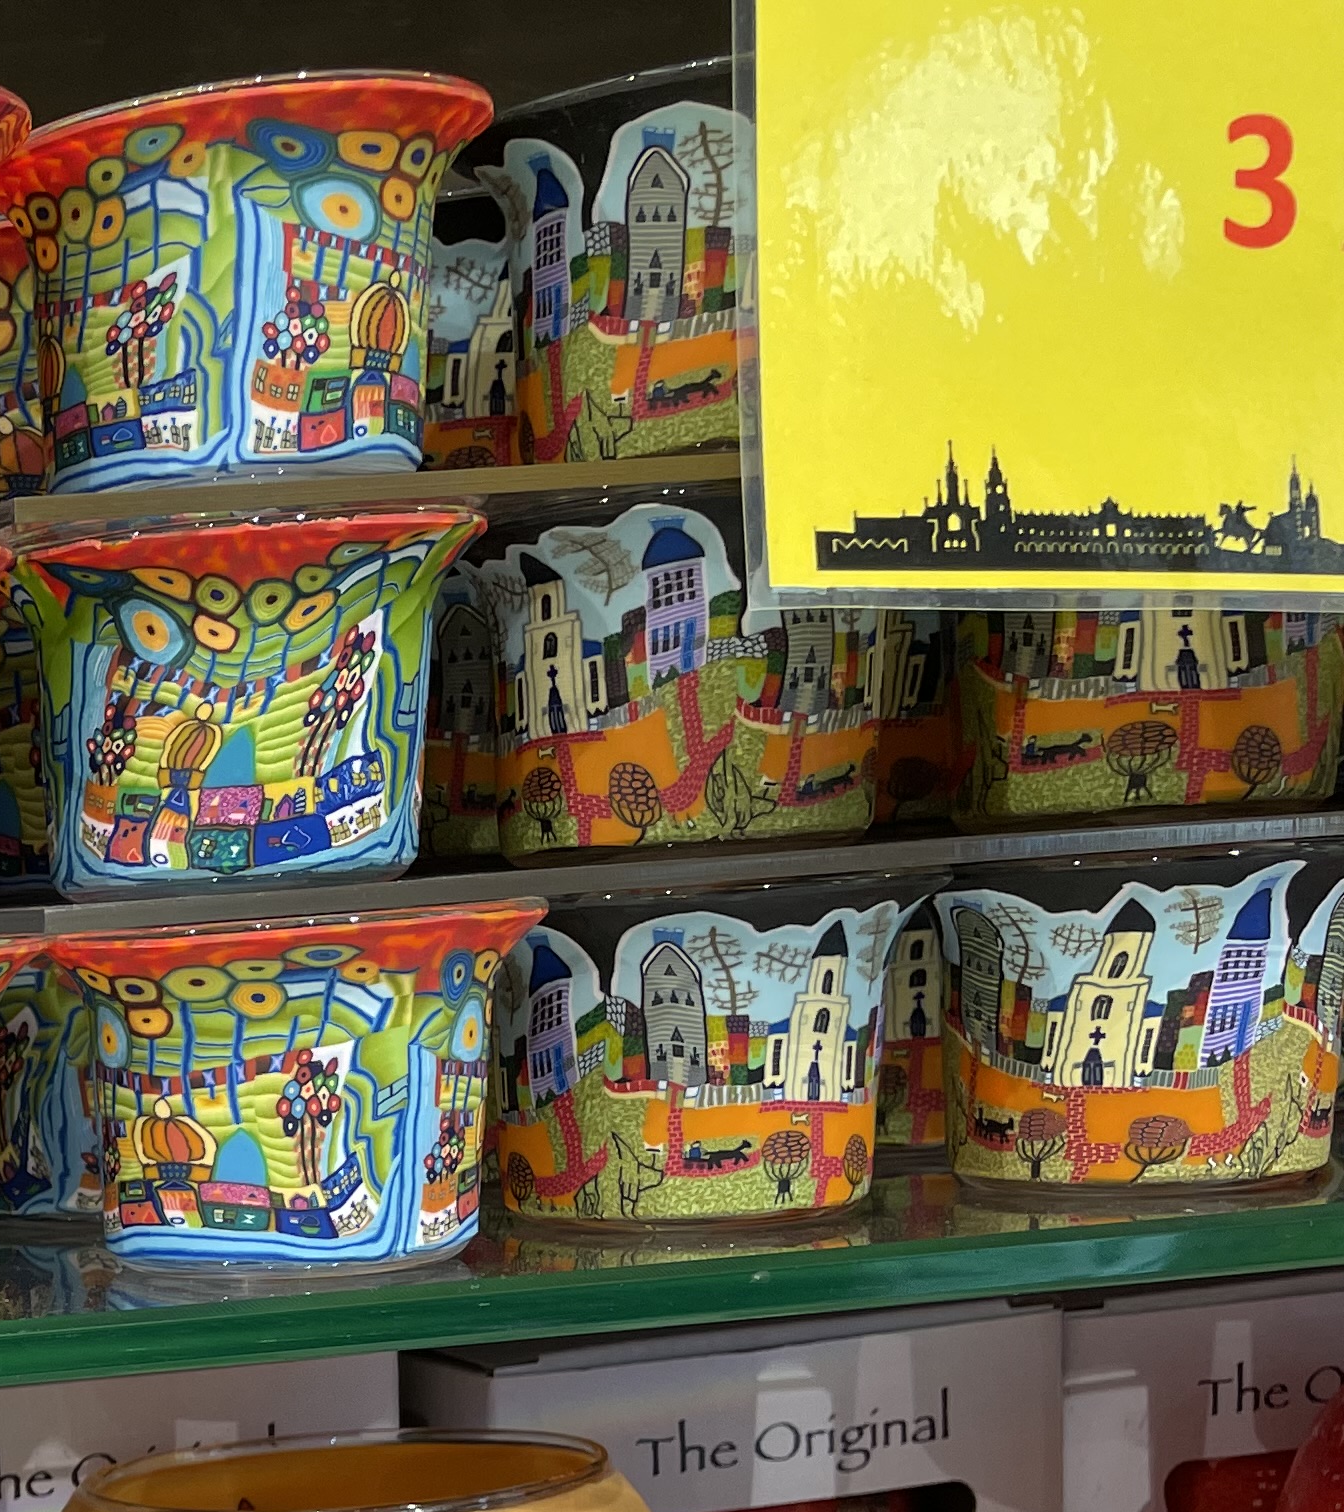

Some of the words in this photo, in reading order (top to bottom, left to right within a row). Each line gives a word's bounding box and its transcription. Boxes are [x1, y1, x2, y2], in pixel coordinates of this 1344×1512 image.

[1198, 1361, 1289, 1416] The
[634, 1418, 739, 1477] The
[754, 1386, 950, 1474] Original
